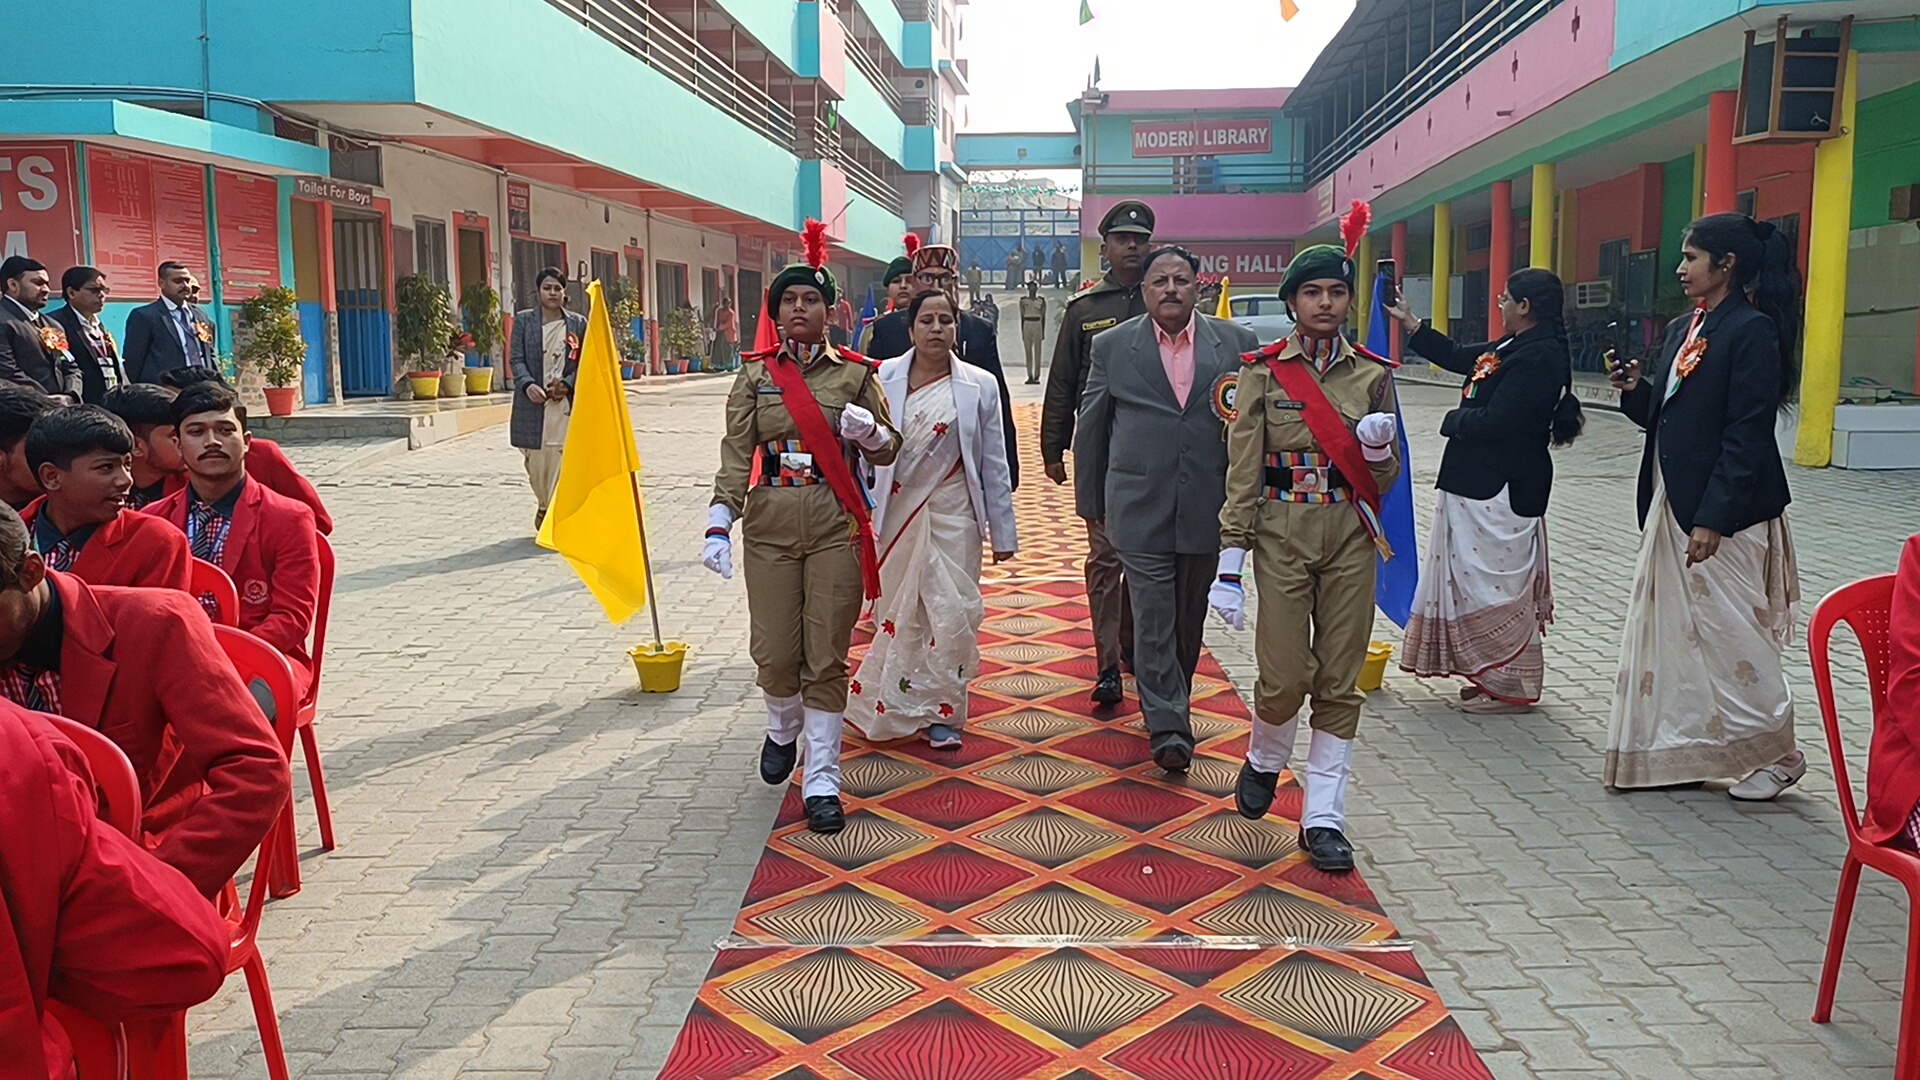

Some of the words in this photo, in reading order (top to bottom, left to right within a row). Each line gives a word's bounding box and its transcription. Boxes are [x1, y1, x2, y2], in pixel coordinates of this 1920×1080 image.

[1135, 130, 1199, 148] MODERN
[1203, 127, 1268, 146] LIBRARY
[298, 180, 327, 196] Toilet
[330, 184, 346, 199] For
[348, 188, 370, 205] Boys
[1235, 254, 1288, 273] HALL
